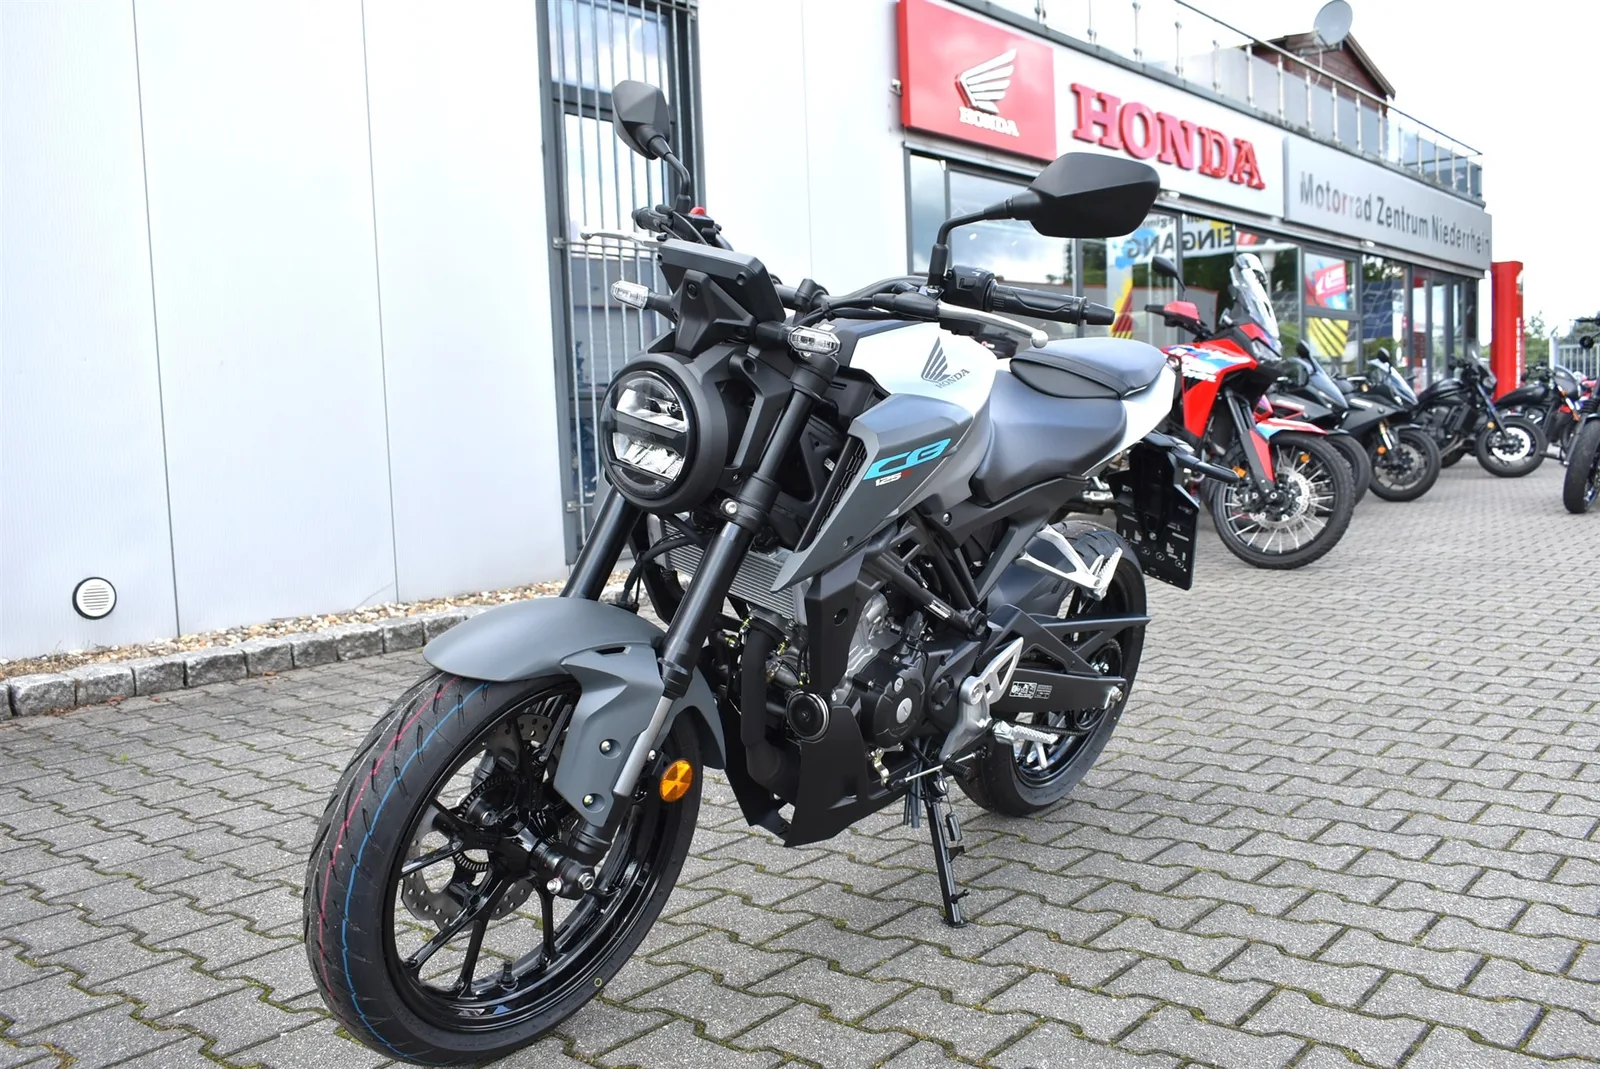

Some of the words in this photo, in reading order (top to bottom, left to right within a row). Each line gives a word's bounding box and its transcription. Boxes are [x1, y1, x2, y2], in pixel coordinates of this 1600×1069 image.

[959, 106, 1019, 137] HONDA
[1071, 83, 1265, 189] HONDA
[1300, 171, 1372, 222] Motorrad
[1377, 196, 1428, 239] Zentrum
[1431, 214, 1490, 257] Niederrhein
[935, 368, 970, 389] HONDA
[863, 438, 951, 481] CB
